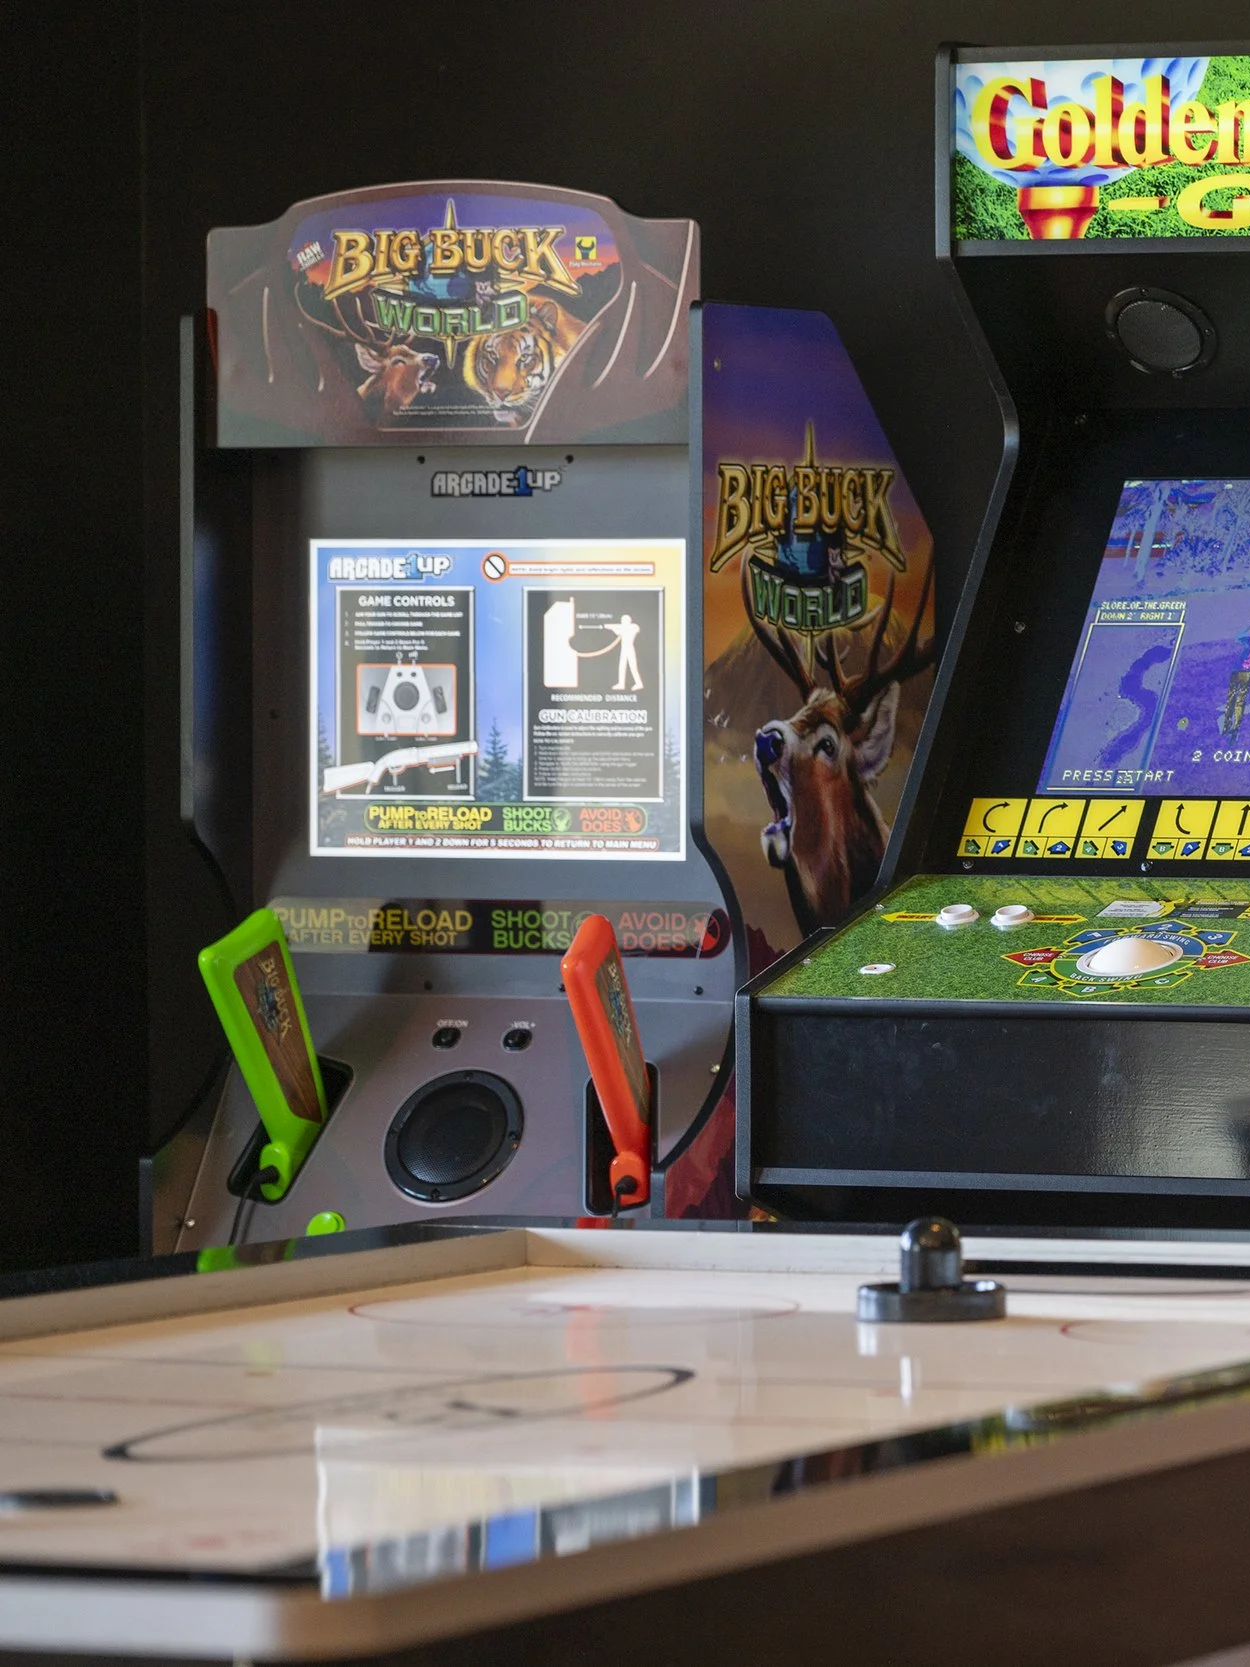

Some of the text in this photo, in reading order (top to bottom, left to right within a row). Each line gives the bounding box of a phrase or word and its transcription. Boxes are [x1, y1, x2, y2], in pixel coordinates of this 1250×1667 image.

[323, 224, 584, 300] BIG BUCK
[371, 288, 530, 338] WORLD
[431, 465, 562, 497] ARCADE1UP
[710, 462, 907, 572] BIG BUCK
[749, 556, 868, 631] WORLD
[358, 595, 455, 607] GAME CONTROLS
[539, 709, 648, 723] GUN CALIBRATION
[1192, 750, 1203, 762] 2
[1062, 769, 1114, 781] PRESS
[369, 806, 415, 821] PUMP
[427, 807, 492, 821] RELOAD
[502, 807, 552, 820] SHOOT
[579, 808, 622, 820] AVOID
[378, 819, 482, 830] AFTER EVERY SHOT
[503, 820, 551, 832] BUCKS
[581, 820, 622, 832] DOES
[435, 838, 441, 846] 2
[442, 838, 469, 846] DOWN
[497, 839, 539, 847] SECONDS
[541, 839, 553, 847] TO
[592, 840, 604, 848] TO
[605, 840, 629, 848] MAIN
[630, 840, 657, 848] MENU
[276, 908, 345, 929] PUMP
[368, 909, 473, 931] RELOAD
[491, 910, 571, 929] SHOOT
[618, 912, 686, 931] AVOID
[1159, 923, 1174, 933] 2
[288, 929, 458, 945] AFTER EVERY SHOT
[493, 930, 571, 949] BUCKS
[623, 932, 687, 951] DOES
[1163, 932, 1190, 946] SWING
[1207, 932, 1223, 941] 3
[1070, 972, 1143, 983] BACK SWING
